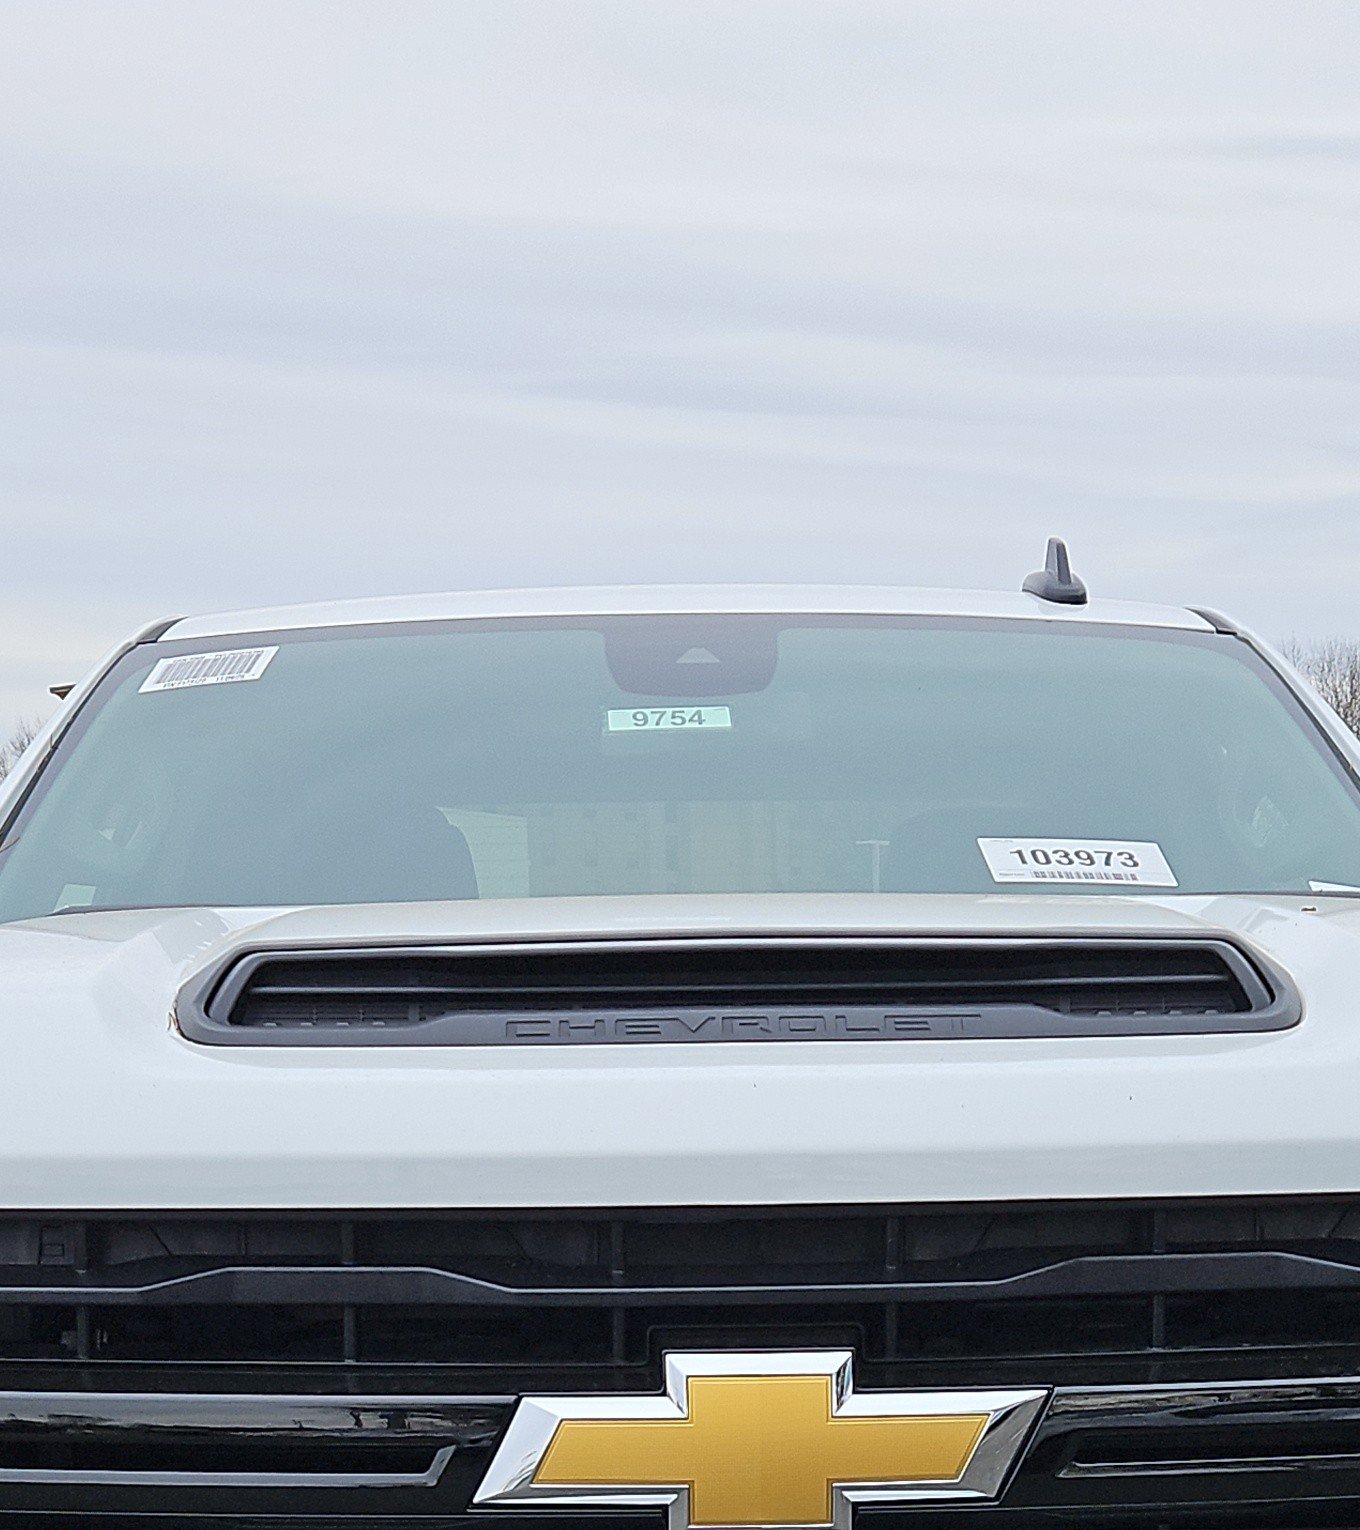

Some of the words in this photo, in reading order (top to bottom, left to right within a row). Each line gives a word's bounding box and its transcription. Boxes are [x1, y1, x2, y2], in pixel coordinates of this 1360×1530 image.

[631, 709, 706, 727] 9754
[1009, 848, 1140, 868] 103973
[505, 1013, 982, 1038] CHEVROLET
